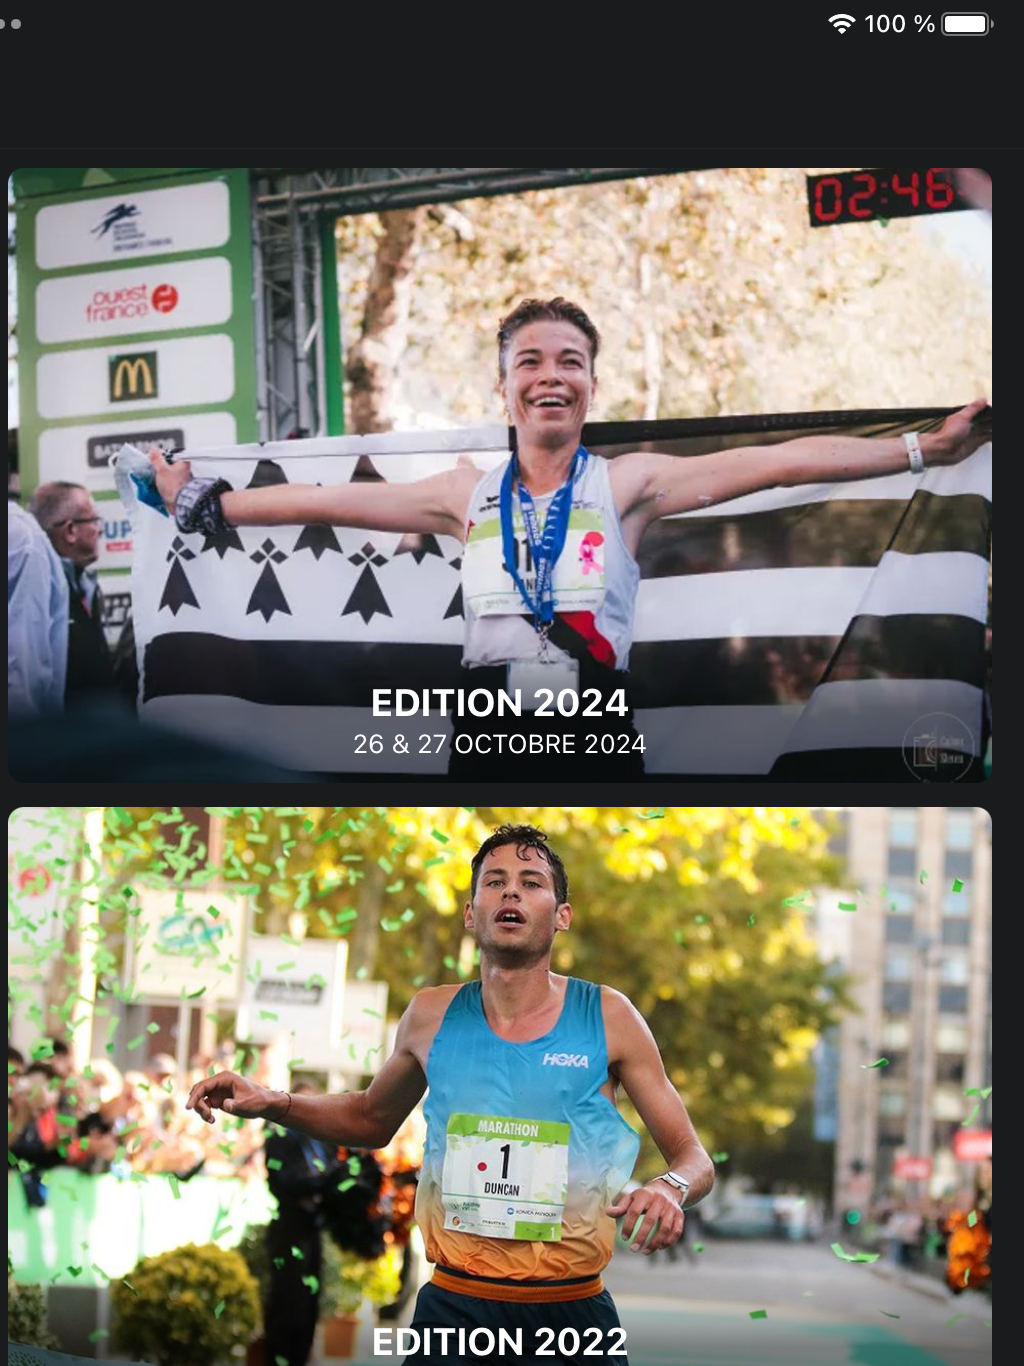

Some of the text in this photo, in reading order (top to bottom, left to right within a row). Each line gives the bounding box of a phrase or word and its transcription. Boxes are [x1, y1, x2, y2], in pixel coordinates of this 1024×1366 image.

[864, 14, 936, 33] 100 %
[542, 1053, 589, 1069] HOKA
[477, 1119, 540, 1137] MARATHON
[500, 1144, 510, 1179] 1
[484, 1182, 520, 1197] DUNCAN
